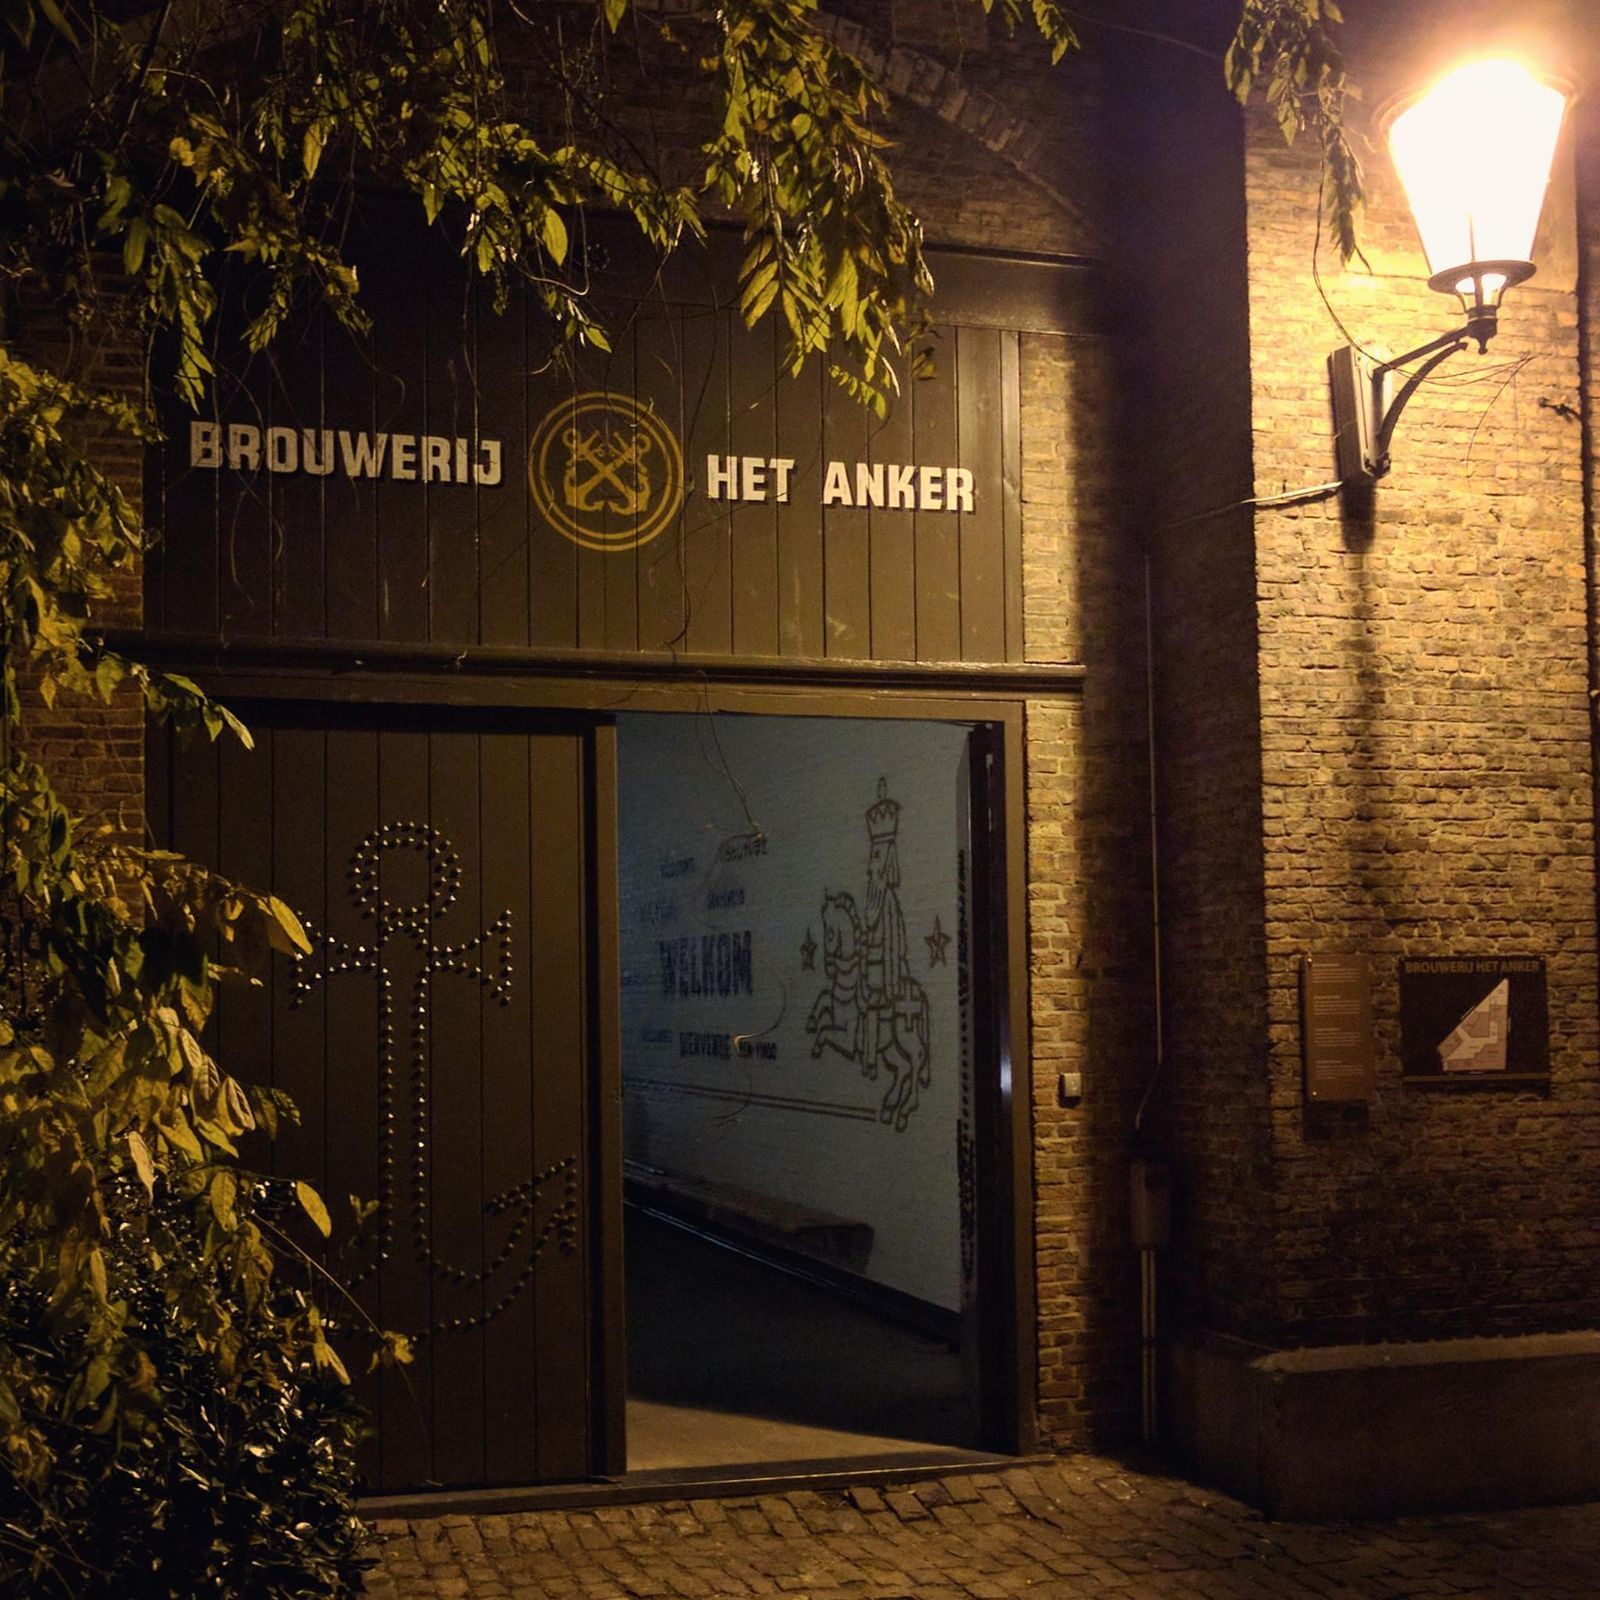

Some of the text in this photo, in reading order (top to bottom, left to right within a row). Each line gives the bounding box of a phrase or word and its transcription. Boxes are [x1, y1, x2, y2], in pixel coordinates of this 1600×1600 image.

[190, 421, 974, 512] BROUWERIJ HET ANKER
[657, 930, 753, 999] WELKOM
[1405, 960, 1540, 974] BROUWERIJ HET ANKER
